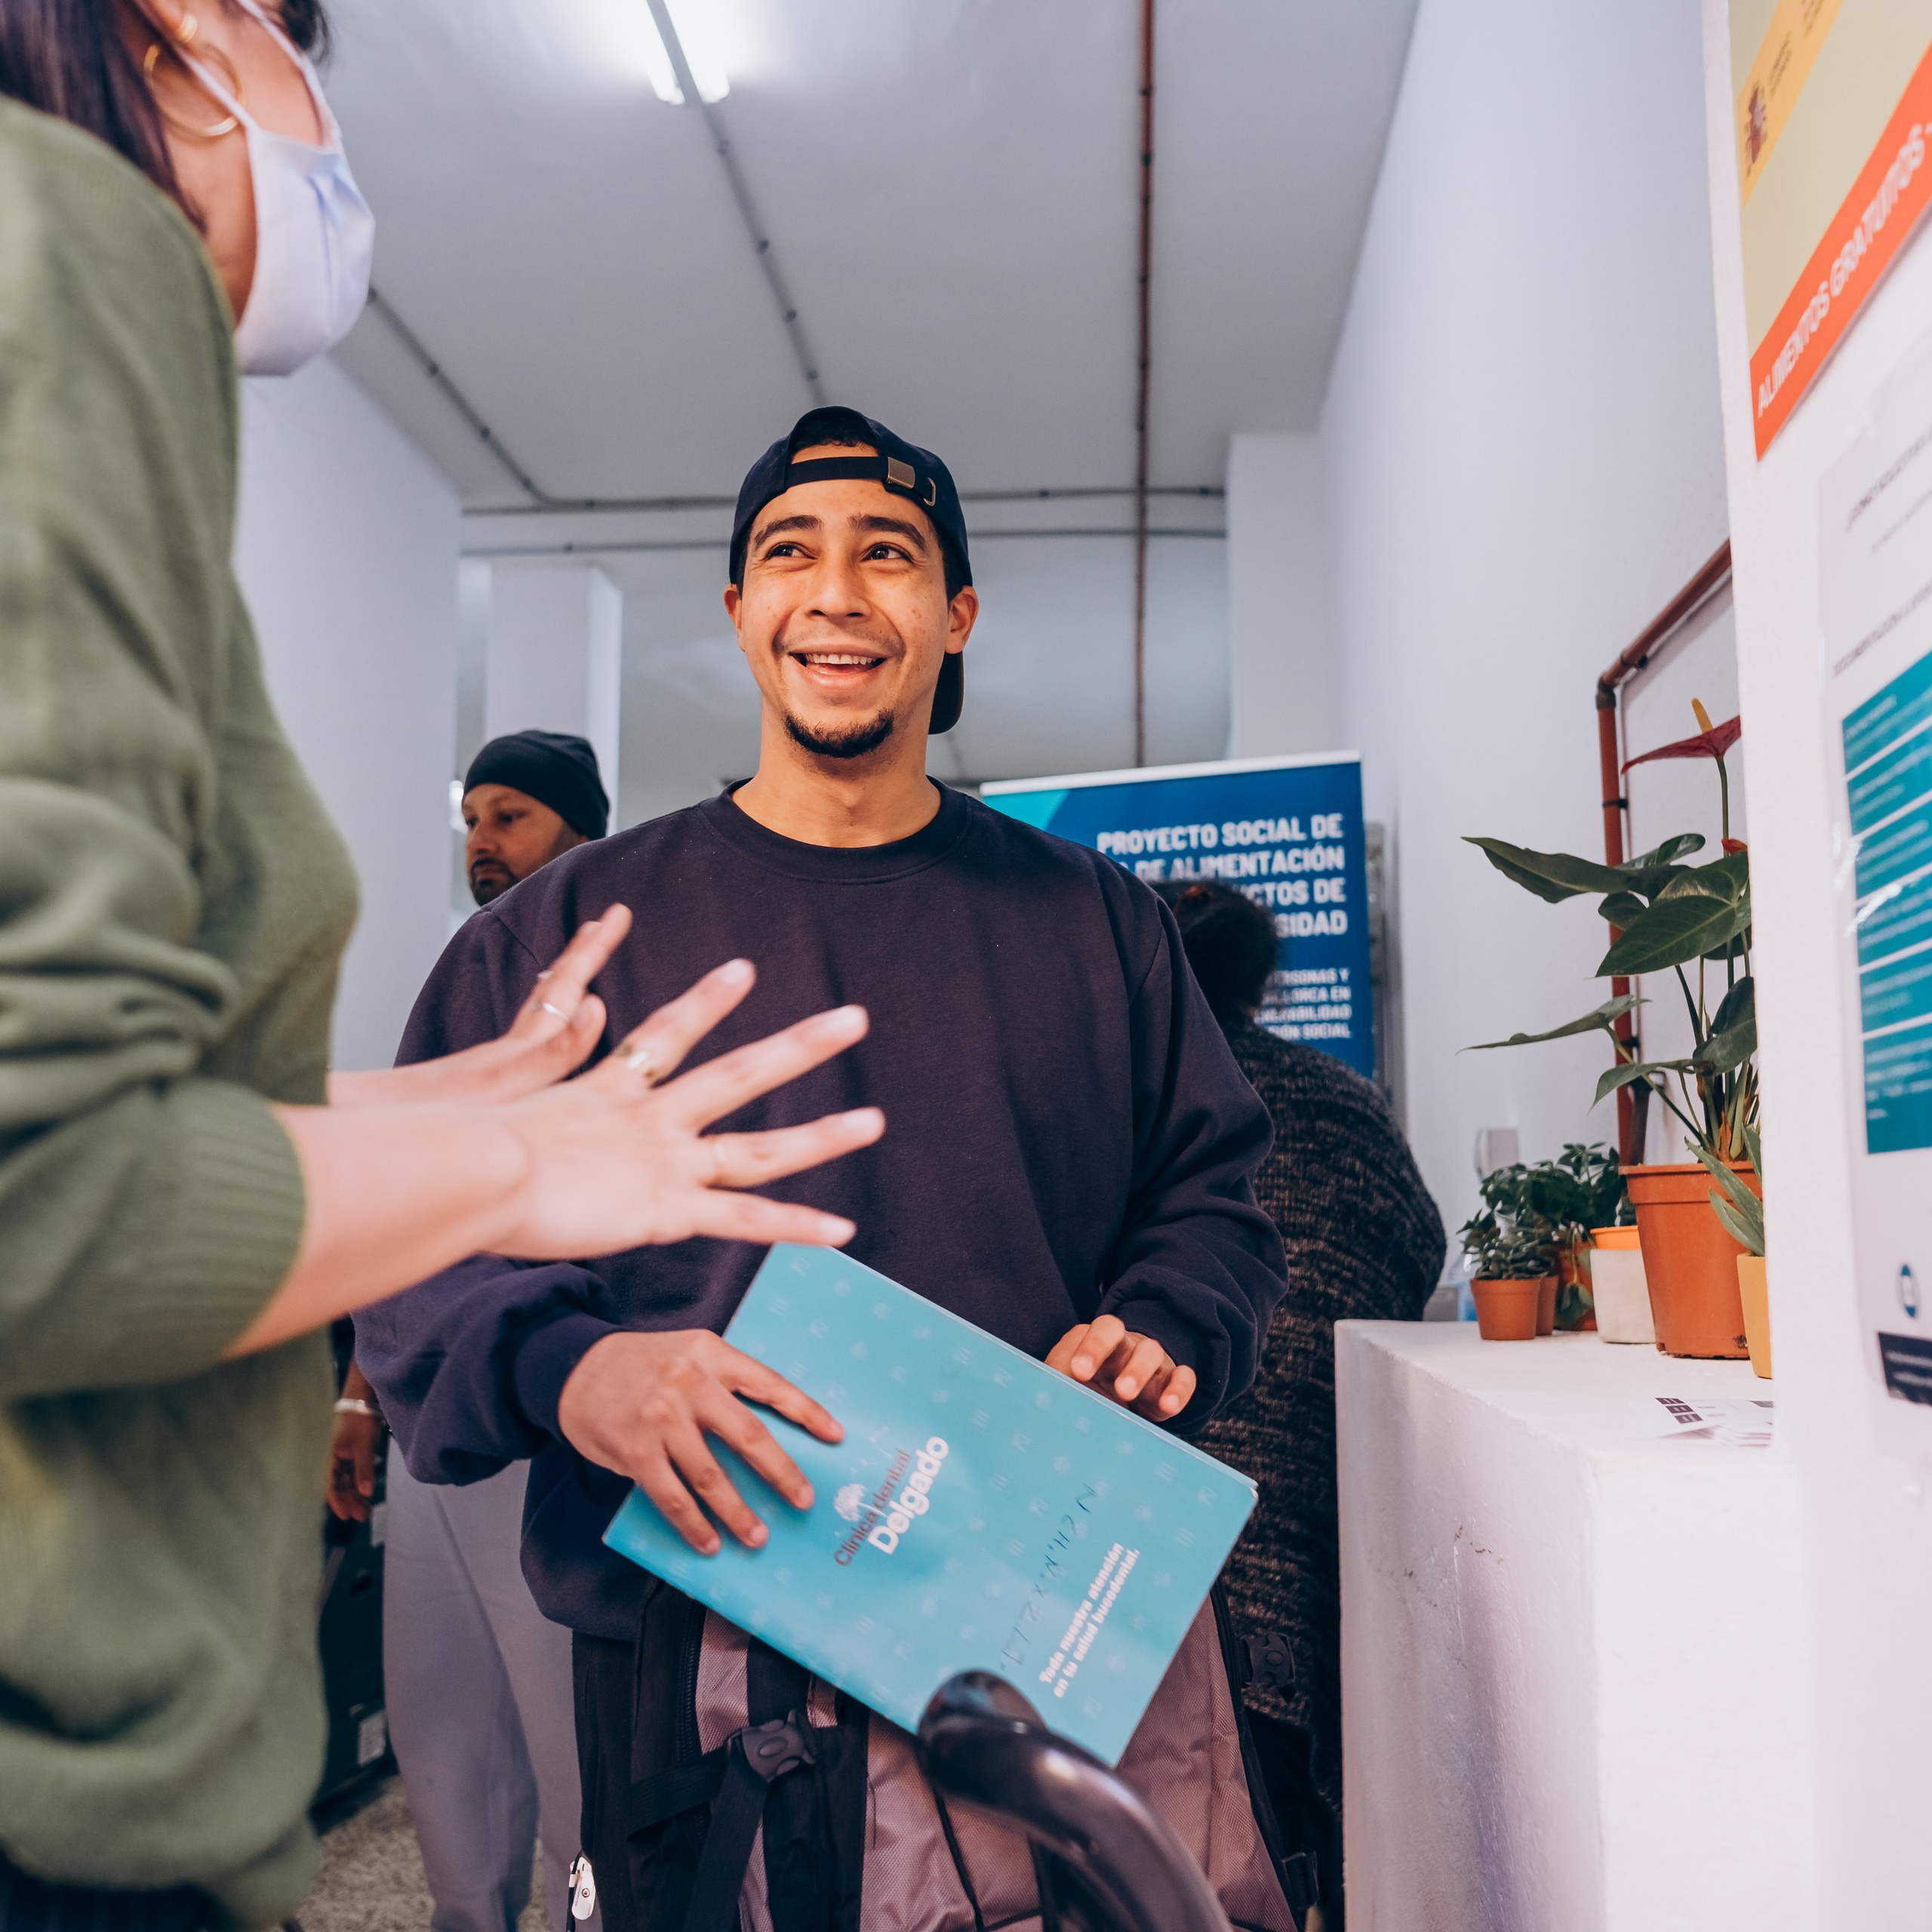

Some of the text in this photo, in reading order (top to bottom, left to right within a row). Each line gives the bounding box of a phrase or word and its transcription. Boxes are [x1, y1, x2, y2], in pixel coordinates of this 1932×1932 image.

[1757, 122, 1924, 419] ALIMENTOS GRATUITOS
[1097, 812, 1344, 856] PROYECTO SOCIAL DE
[1171, 841, 1346, 881] ALIMENTACIÓN
[1240, 876, 1346, 907] CTOS DE
[1274, 909, 1348, 939] SIDAD
[1330, 985, 1352, 1002] EN
[1339, 966, 1350, 983] Y
[1302, 1022, 1352, 1041] SOCIAL
[867, 1436, 950, 1555] Delgado
[872, 1447, 911, 1510] dental
[1038, 1651, 1066, 1684] Toda
[1060, 1599, 1094, 1653] nuestra
[1054, 1678, 1069, 1698] en
[1062, 1660, 1079, 1679] tu
[1072, 1622, 1099, 1662] salud
